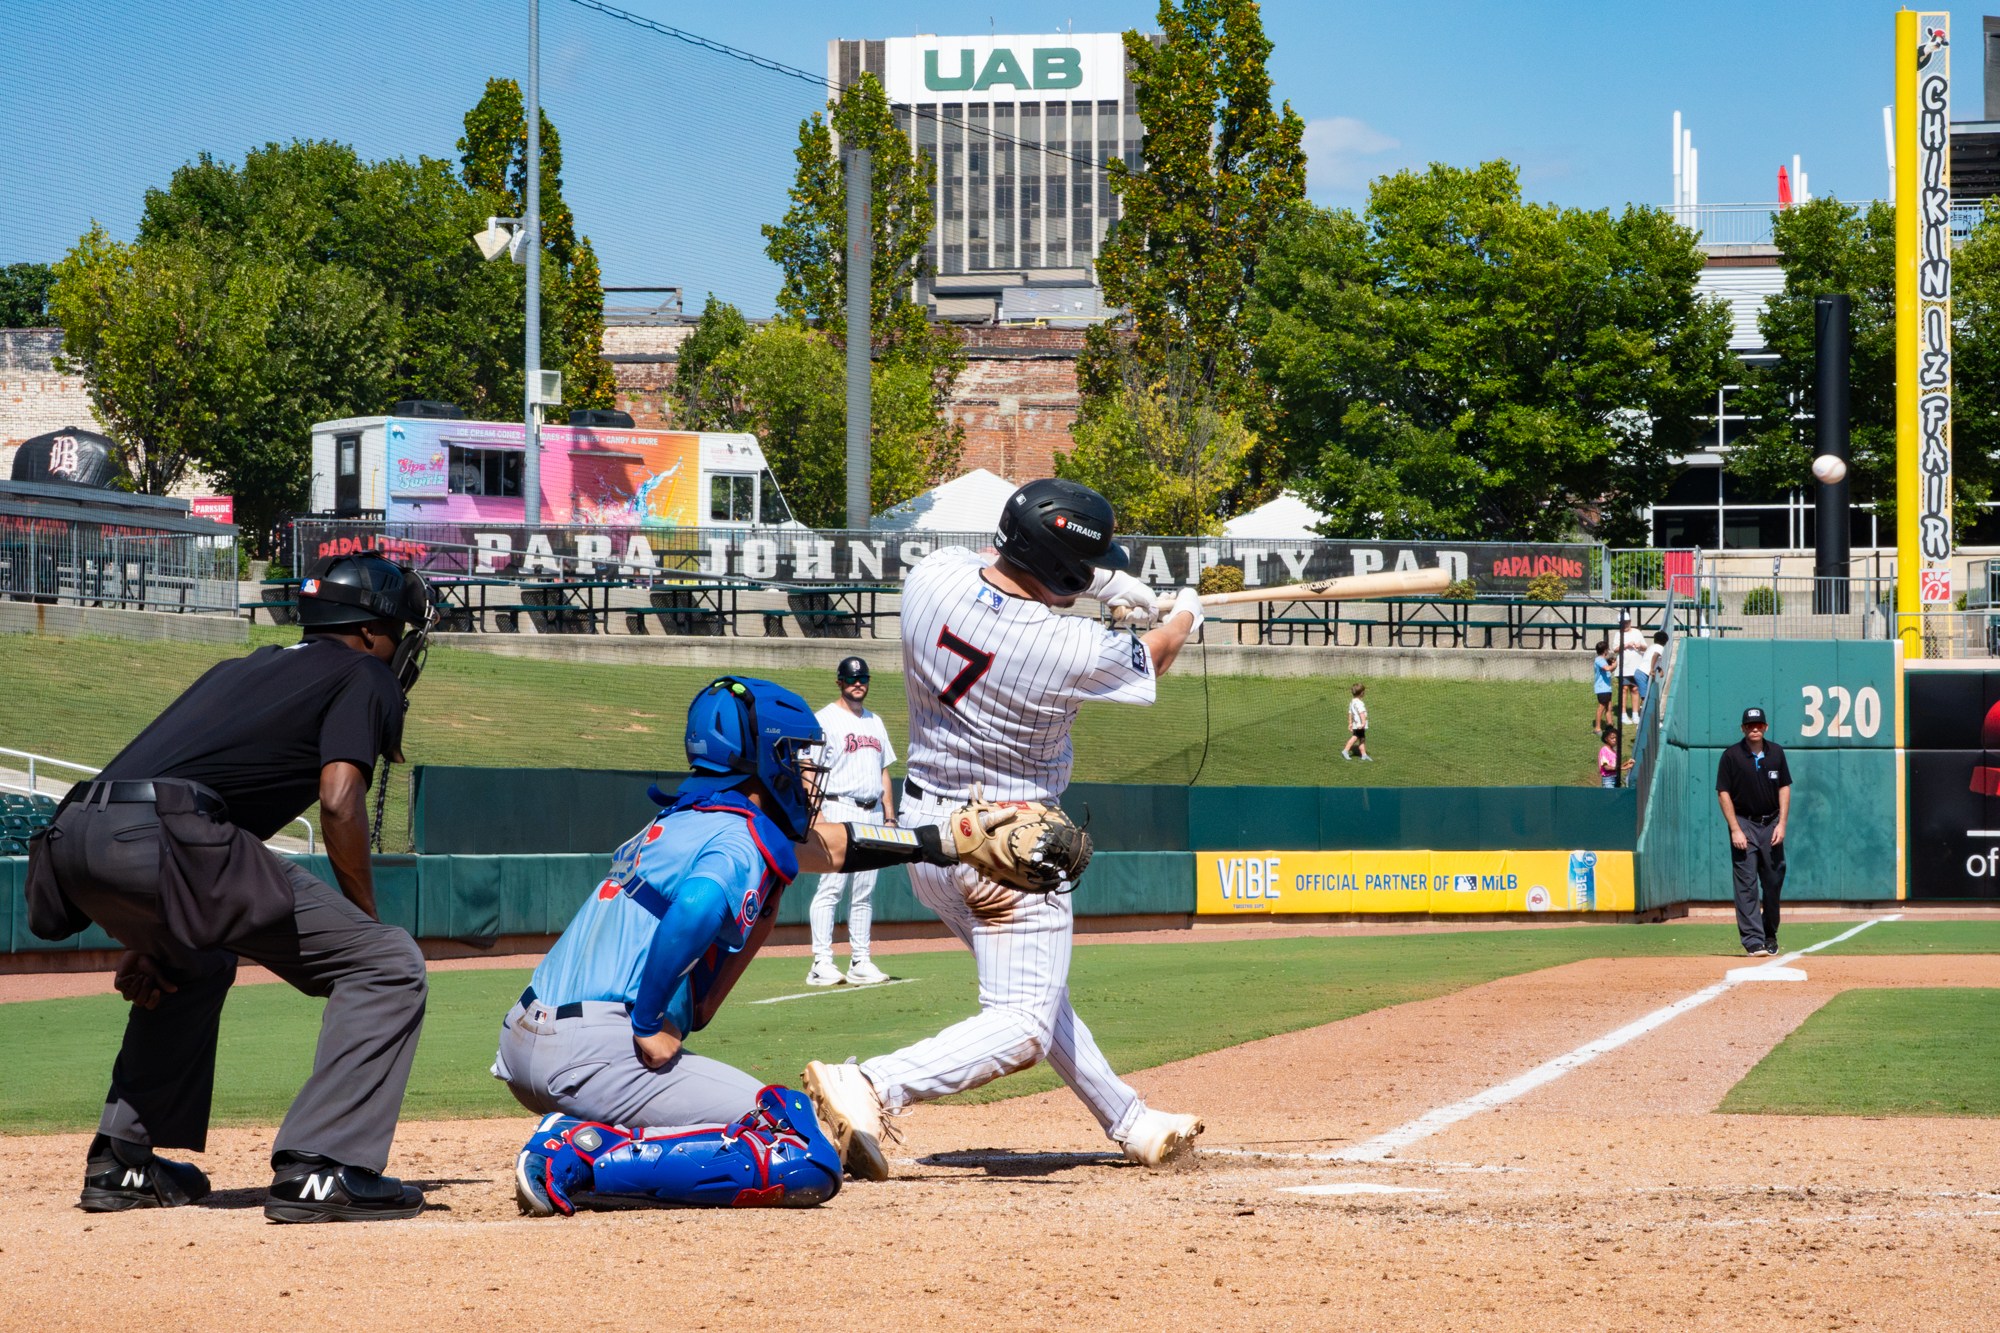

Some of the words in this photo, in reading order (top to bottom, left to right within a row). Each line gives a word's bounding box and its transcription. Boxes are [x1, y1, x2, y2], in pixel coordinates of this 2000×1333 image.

[924, 47, 1083, 91] UAB
[1920, 75, 1949, 299] CHIKIN
[1920, 309, 1950, 387] IZ
[470, 429, 496, 437] CREAM
[497, 430, 521, 439] CONES
[606, 436, 629, 444] CANDY
[638, 438, 658, 446] MORE
[1921, 395, 1950, 560] FAIR
[195, 504, 230, 513] PARKSIDE
[1066, 521, 1102, 541] STRAUSS
[474, 532, 661, 577] PAPA
[1119, 545, 1315, 587] ARTY
[936, 624, 995, 707] 7
[1801, 685, 1881, 738] 320
[1295, 874, 1360, 891] OFFICIAL
[1365, 874, 1427, 891] PARTNER
[1433, 875, 1450, 891] OF
[121, 1168, 144, 1188] N
[299, 1174, 334, 1200] N
